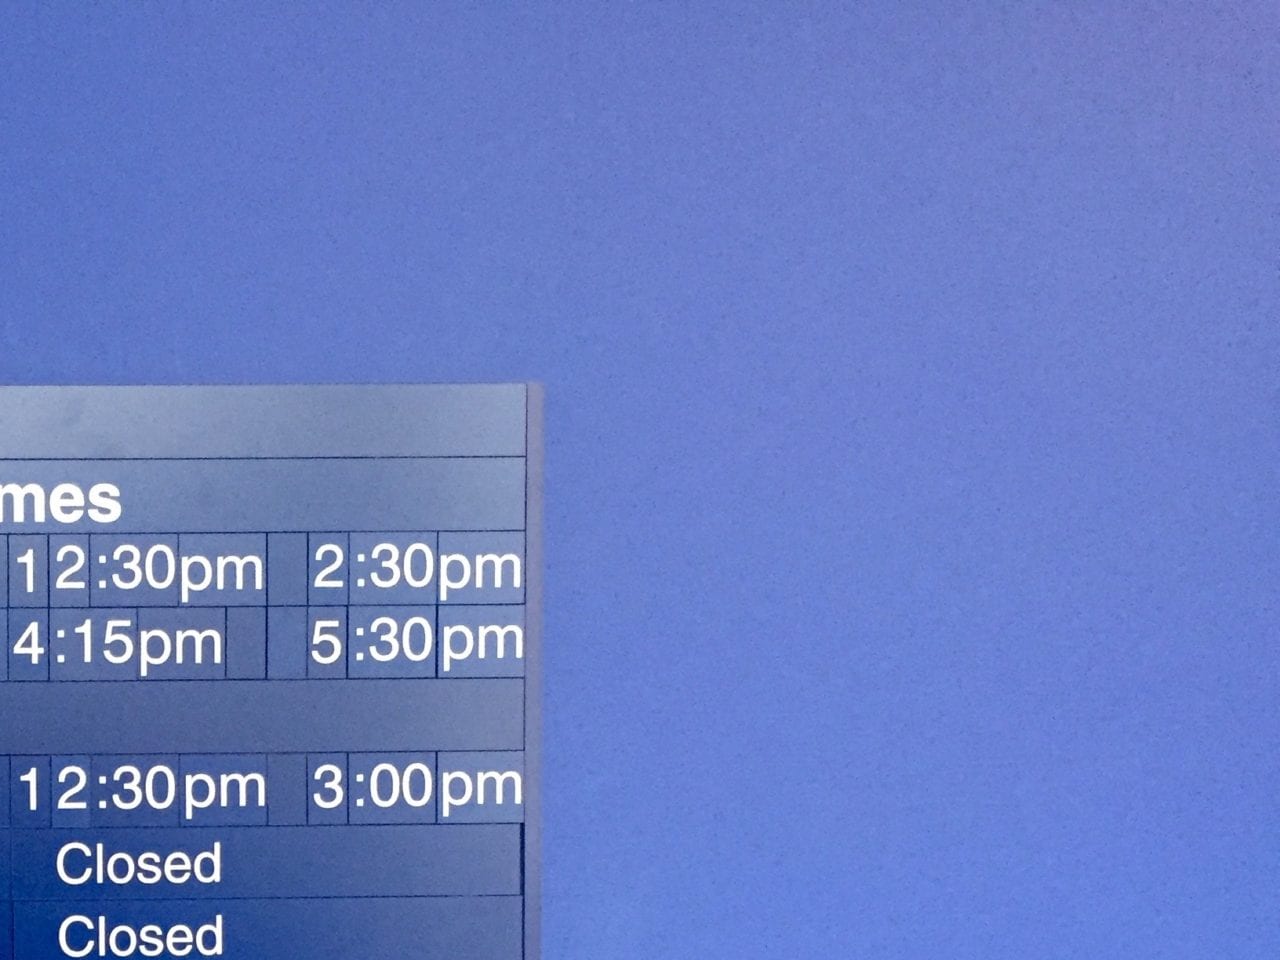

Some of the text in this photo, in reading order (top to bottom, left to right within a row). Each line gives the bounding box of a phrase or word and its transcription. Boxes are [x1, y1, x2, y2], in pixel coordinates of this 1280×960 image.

[313, 541, 523, 603] 2:30pm
[12, 615, 525, 678] 4:15pm 5:30pm
[312, 761, 524, 819] 3:00pm
[55, 840, 222, 886] Closed
[57, 913, 224, 959] Closed
